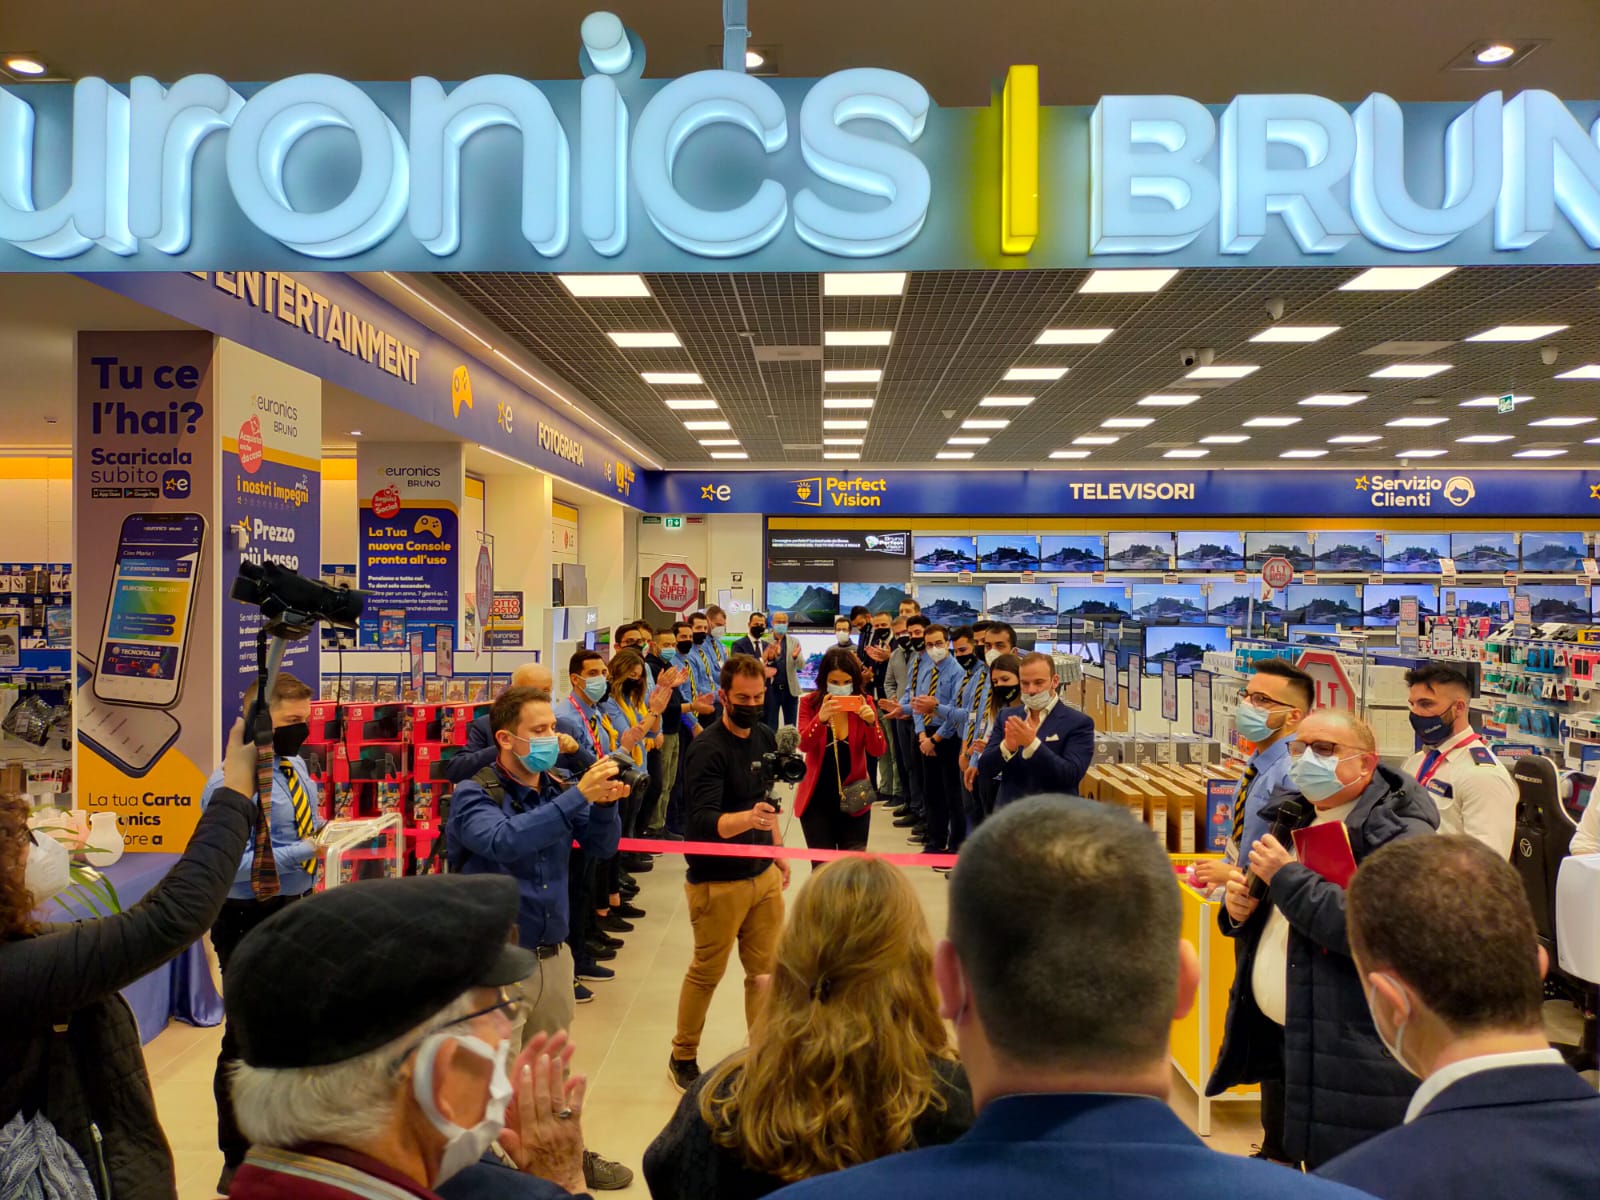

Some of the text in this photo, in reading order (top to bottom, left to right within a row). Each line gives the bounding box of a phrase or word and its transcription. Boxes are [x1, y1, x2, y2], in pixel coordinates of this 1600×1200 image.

[1089, 87, 1600, 256] BRUN
[91, 357, 199, 389] Tu ce
[257, 395, 298, 421] euronics
[273, 421, 298, 438] BRUNO
[538, 421, 584, 467] FOTOGRAFIA
[91, 447, 192, 465] Scaricala
[91, 466, 158, 483] subito
[385, 465, 440, 476] euronics
[826, 477, 886, 491] Perfect
[1371, 475, 1442, 490] Servizio
[242, 480, 272, 497] nostri
[273, 482, 309, 507] impegni
[716, 484, 731, 501] e
[831, 493, 881, 507] Vision
[1069, 483, 1195, 500] TELEVISORI
[1371, 492, 1431, 507] Clienti
[253, 518, 295, 543] Prezzo
[368, 527, 407, 537] La Tua
[368, 541, 451, 551] nuova Console
[368, 555, 407, 567] pronta
[661, 573, 689, 587] ALT
[660, 585, 687, 594] SUPER
[1316, 680, 1339, 708] LT
[89, 792, 191, 806] La tua Carta
